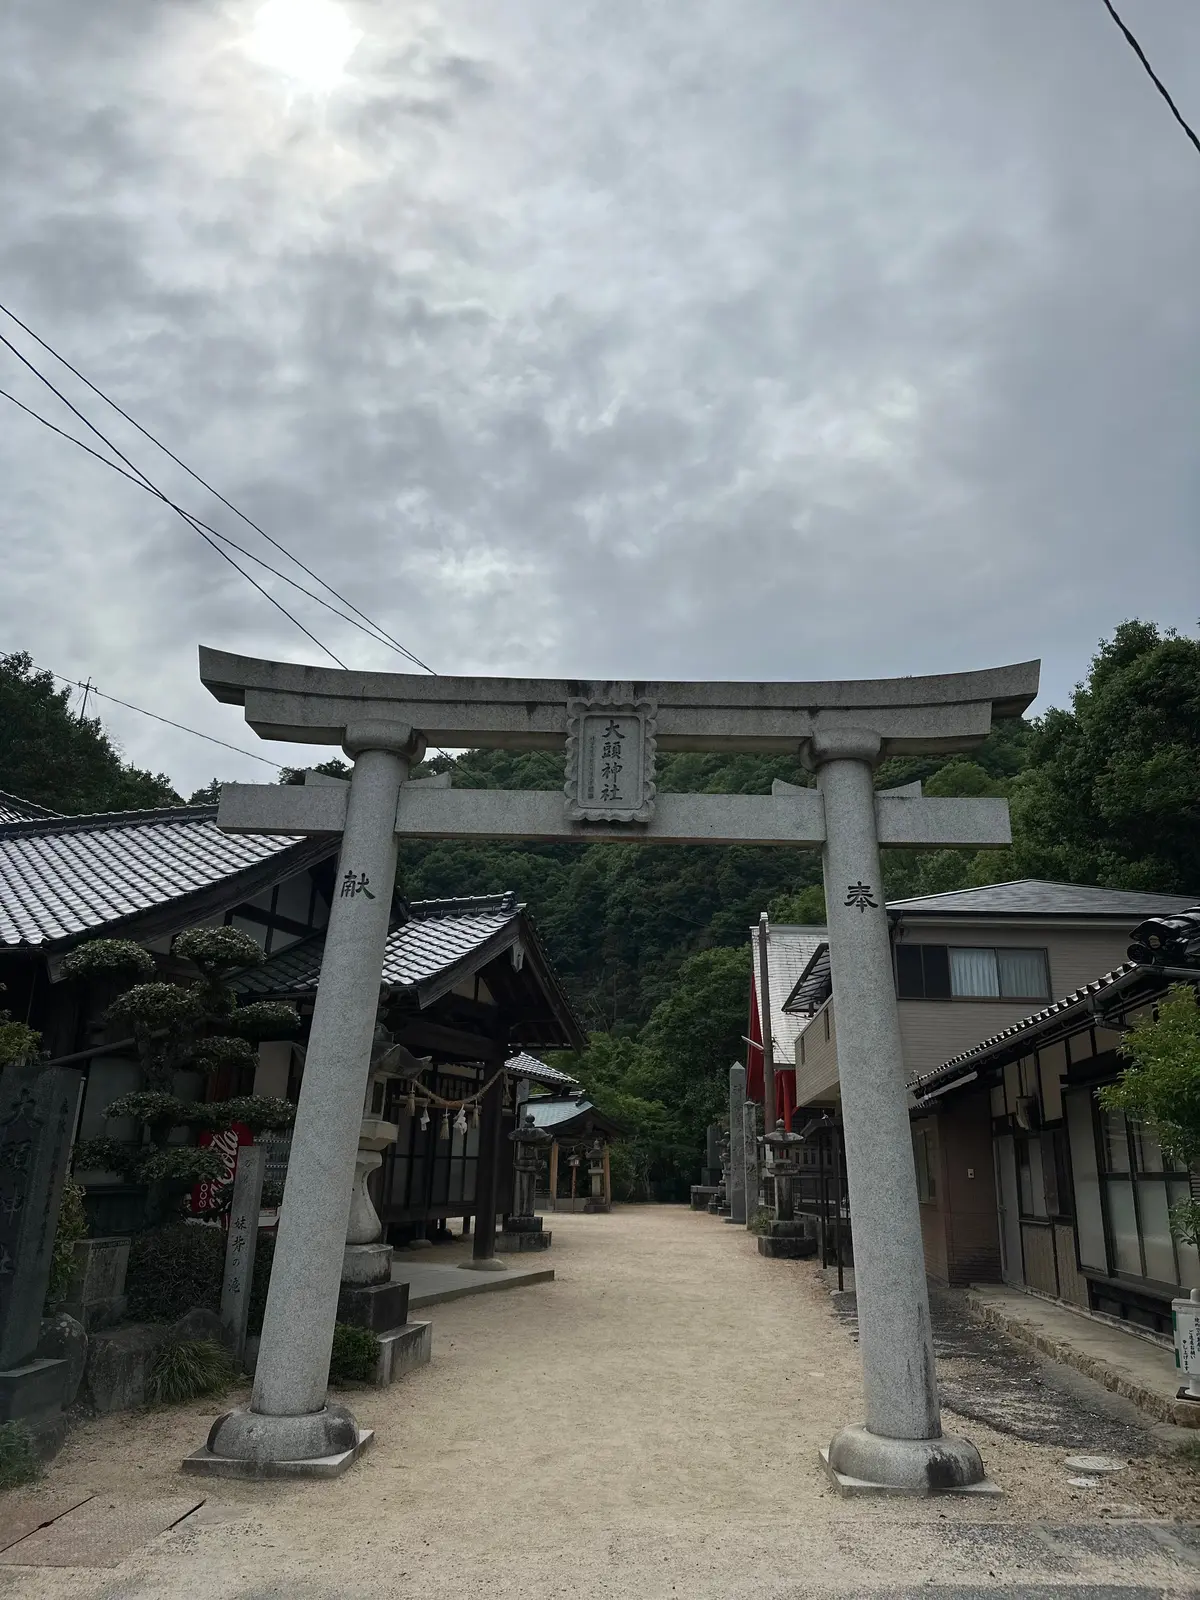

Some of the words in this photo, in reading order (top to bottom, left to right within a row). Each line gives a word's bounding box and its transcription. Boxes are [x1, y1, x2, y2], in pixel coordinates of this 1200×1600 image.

[600, 719, 626, 802] 大頭神社
[340, 869, 376, 900] 献
[843, 880, 879, 914] 奉
